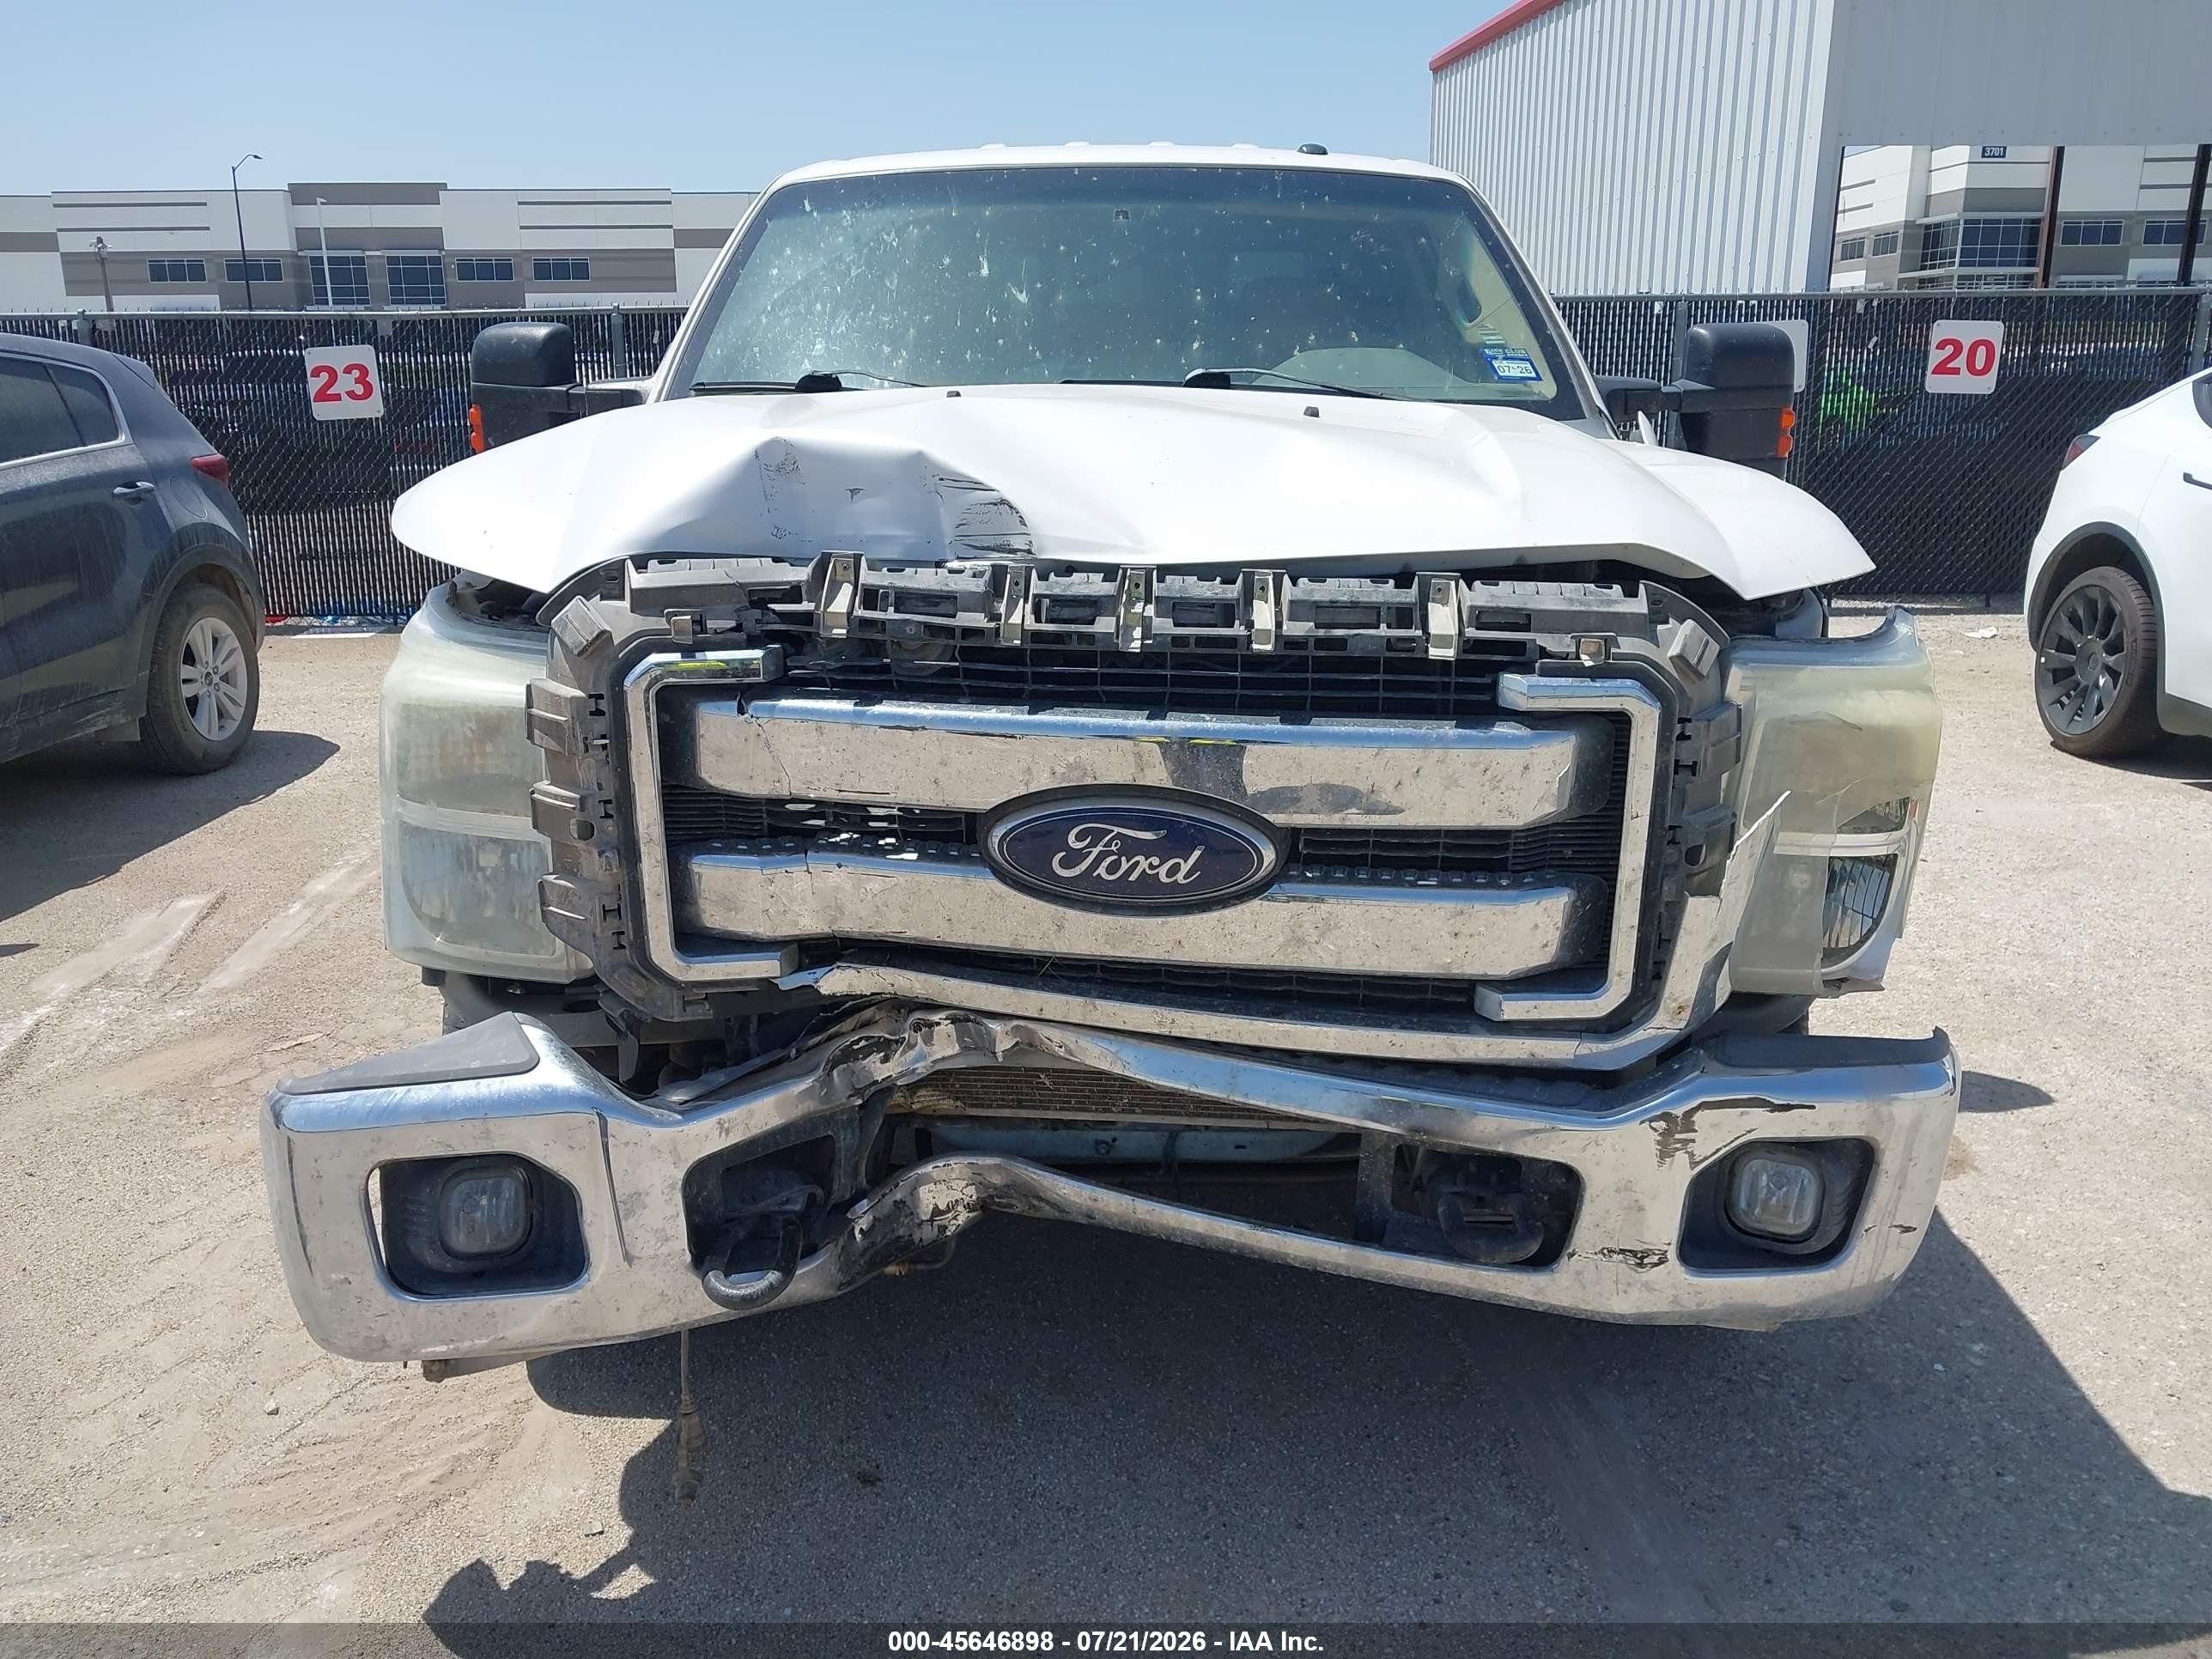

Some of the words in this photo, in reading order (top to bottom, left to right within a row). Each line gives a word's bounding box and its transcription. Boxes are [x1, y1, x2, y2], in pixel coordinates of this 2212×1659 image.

[1984, 147, 2003, 156] 3701
[1930, 337, 1996, 377] 20
[309, 362, 374, 403] 23
[1051, 823, 1206, 884] Ford
